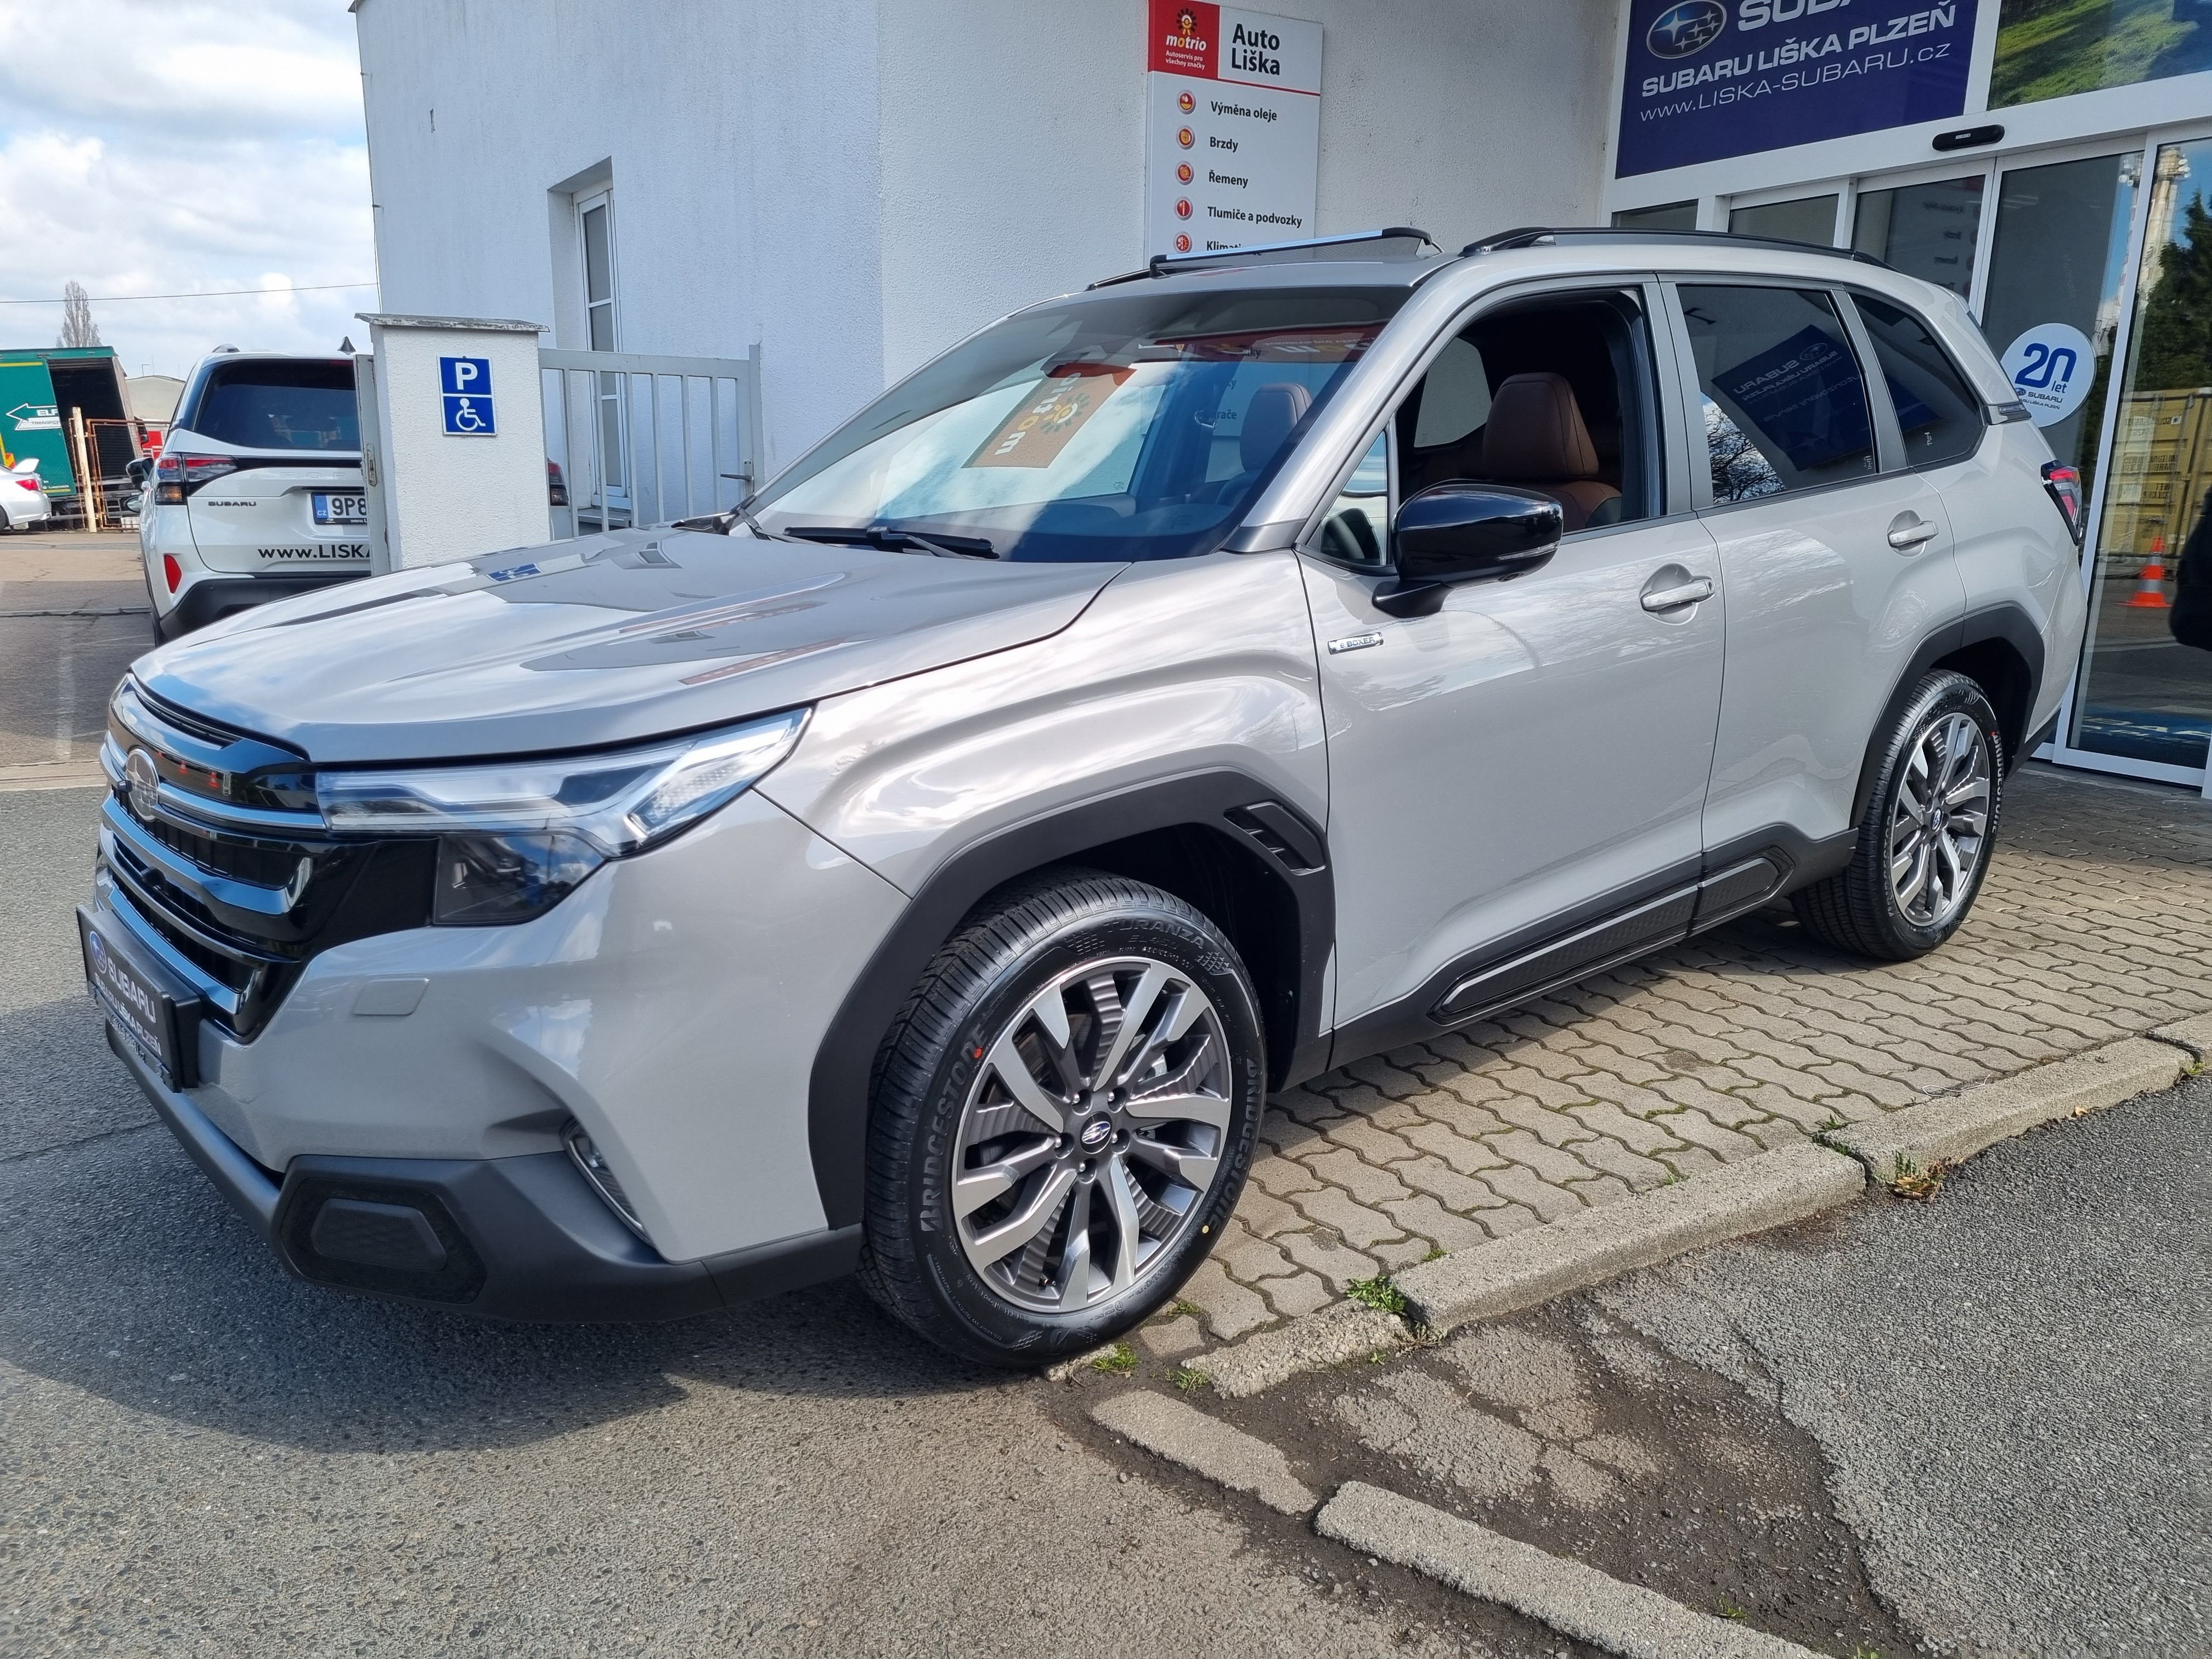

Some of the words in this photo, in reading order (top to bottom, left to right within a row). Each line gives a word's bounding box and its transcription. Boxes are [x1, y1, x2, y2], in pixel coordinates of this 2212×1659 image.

[1166, 35, 1207, 51] motrio
[1232, 24, 1280, 50] Auto
[1165, 50, 1193, 60] Autoservis
[1642, 54, 1753, 97] SUBARU
[1758, 33, 1843, 71] LIŠKA
[1848, 1, 1956, 50] PLZEŇ
[1165, 58, 1187, 67] všechny
[1187, 61, 1205, 70] značky
[1232, 47, 1280, 75] Liška
[1640, 43, 1951, 121] www.LISKA-SUBARU.cz
[1211, 101, 1251, 117] Výměna
[1253, 108, 1277, 122] oleje
[1210, 137, 1239, 153] Brzdy
[1209, 169, 1249, 189] Řemeny
[1207, 206, 1246, 221] Tlumiče
[1248, 213, 1254, 221] a
[1256, 213, 1302, 229] podvozky
[455, 362, 478, 390] P
[2051, 380, 2067, 393] let
[2028, 392, 2063, 403] SUBARU
[332, 498, 366, 516] 9P8
[108, 956, 156, 1024] SUBARU
[921, 1023, 985, 1232] BRIDGESTONE
